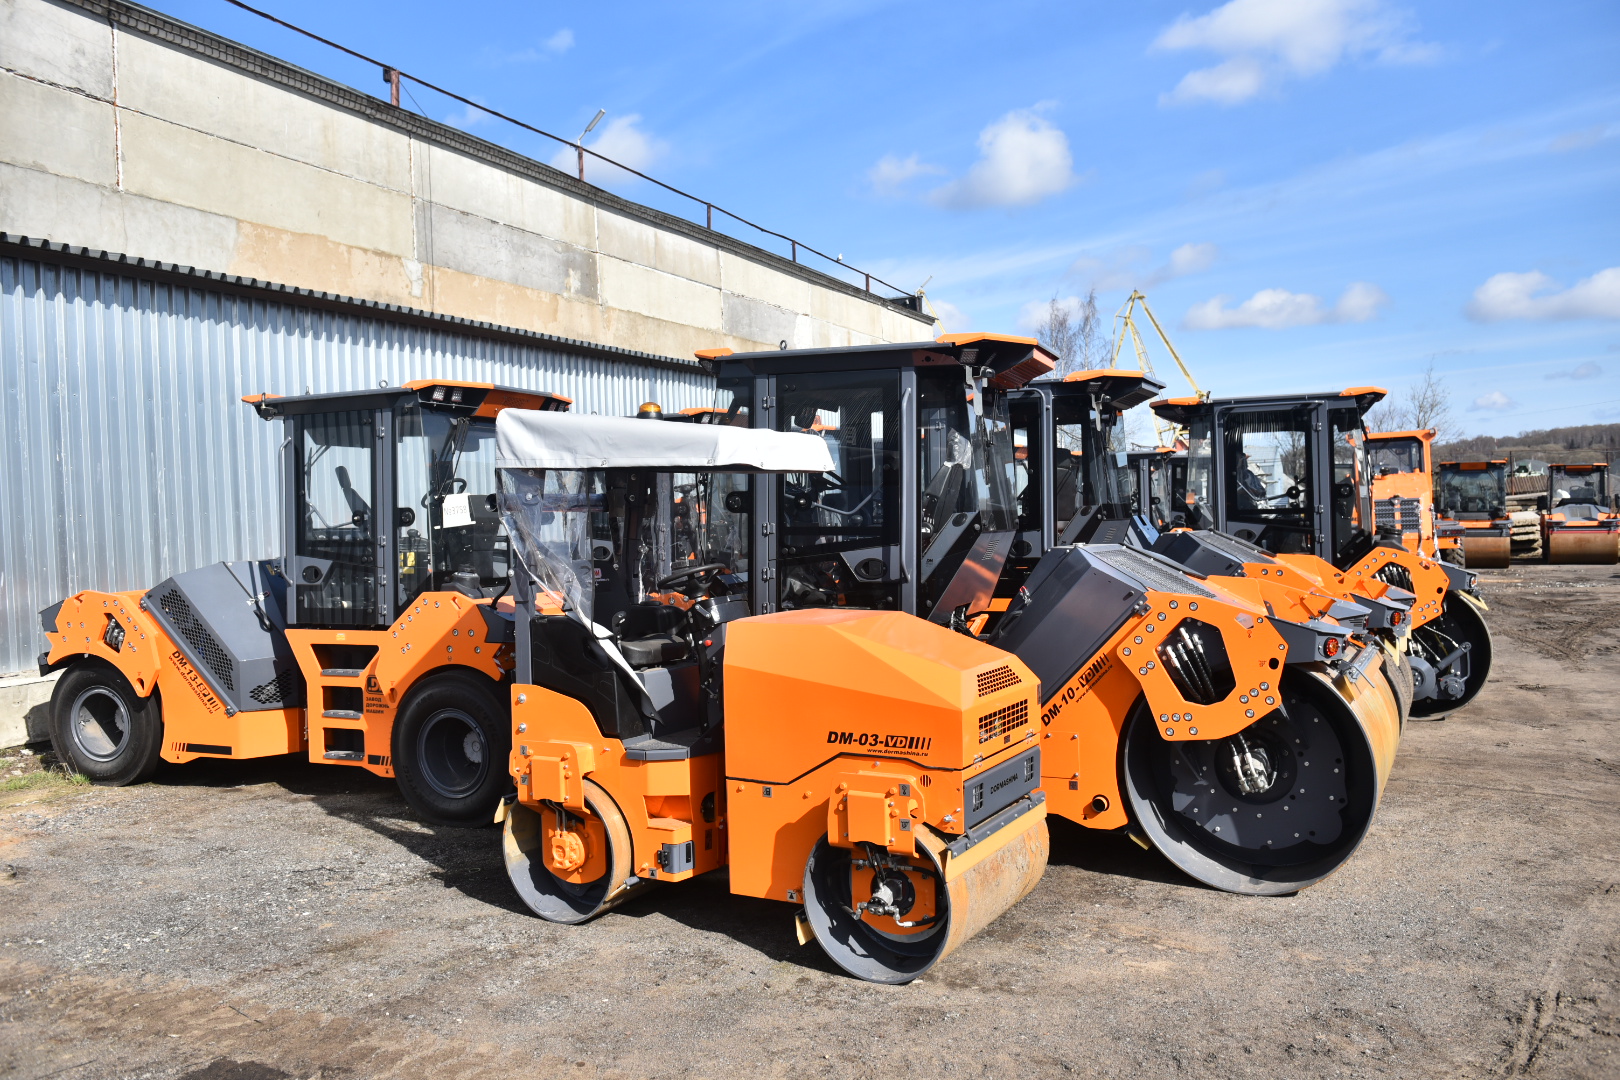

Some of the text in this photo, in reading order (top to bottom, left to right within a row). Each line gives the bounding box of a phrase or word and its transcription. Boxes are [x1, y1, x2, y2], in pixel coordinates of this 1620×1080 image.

[168, 655, 214, 714] www.dormashina.ru
[1040, 666, 1096, 727] DM-10-VD
[826, 731, 909, 749] DM-03-VD
[867, 748, 929, 757] www.dormashina.ru
[990, 773, 1019, 794] DORMASHINA
